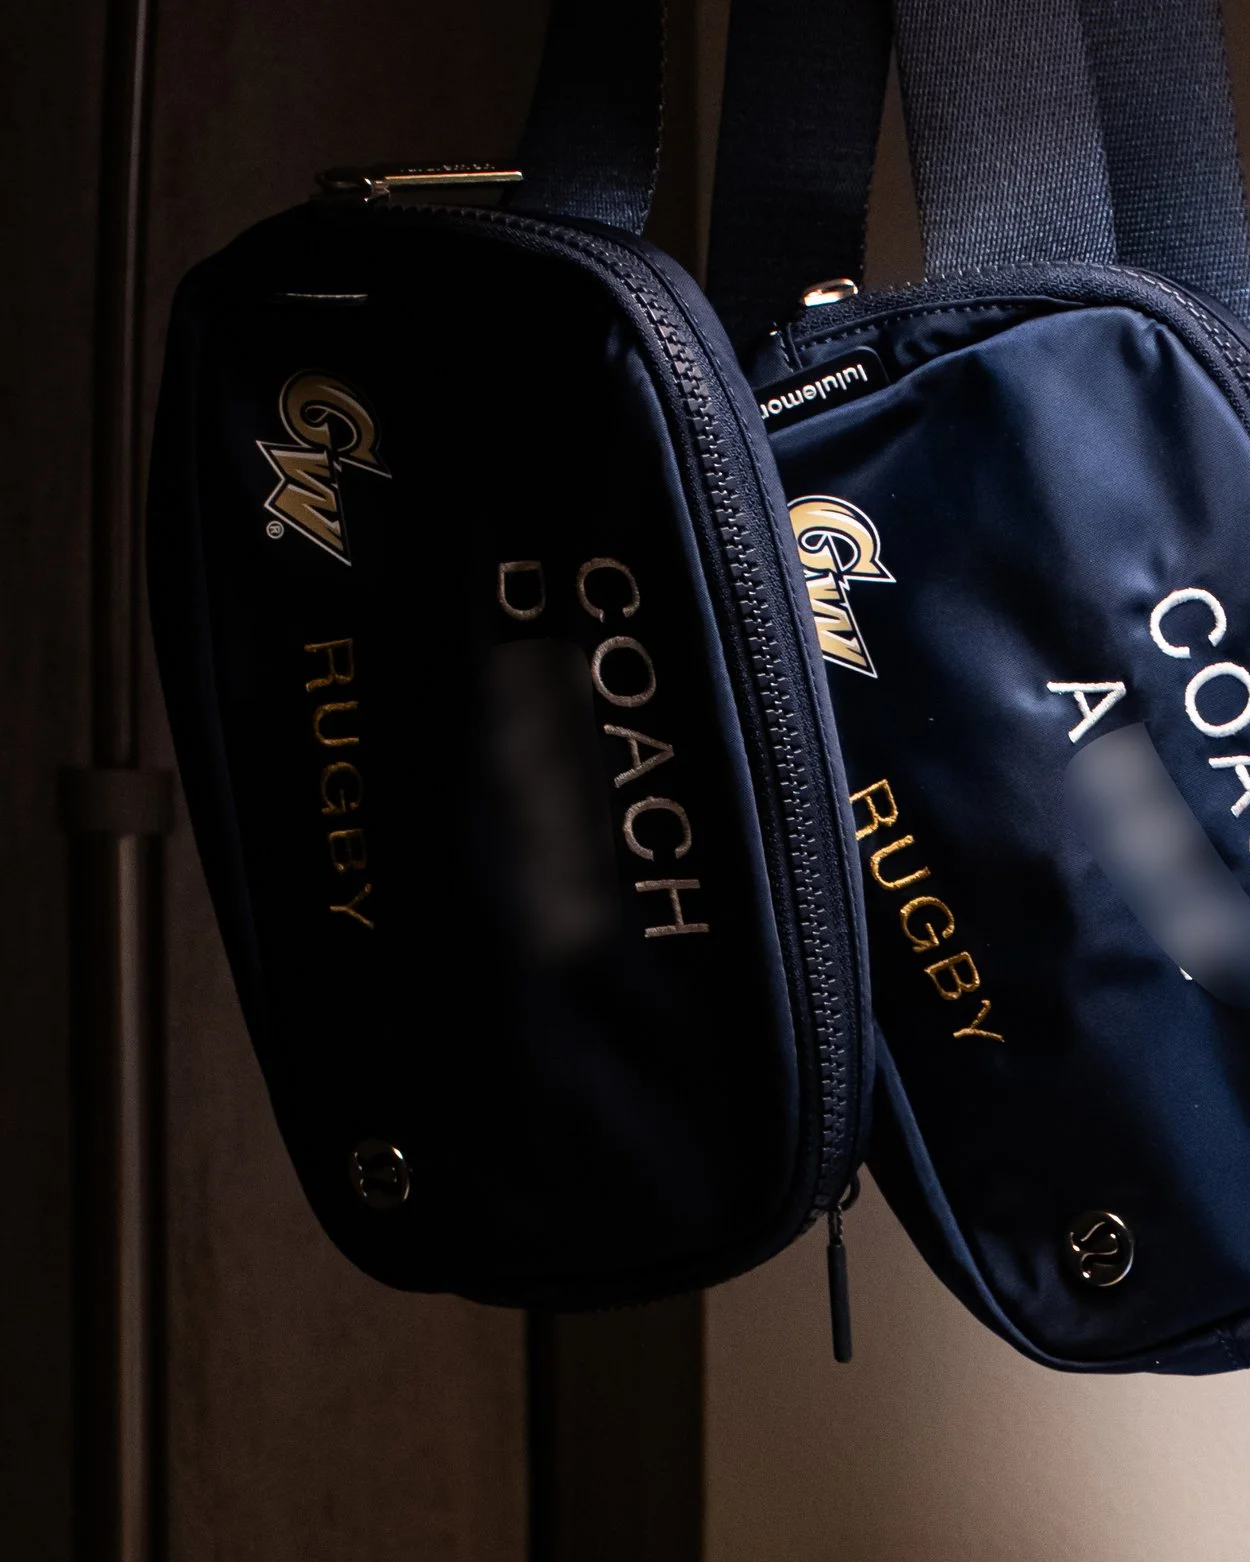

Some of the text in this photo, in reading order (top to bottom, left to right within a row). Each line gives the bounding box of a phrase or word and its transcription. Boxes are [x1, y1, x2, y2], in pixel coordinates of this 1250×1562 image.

[303, 637, 375, 930] RUGBY
[576, 556, 710, 939] COACH
[848, 778, 1006, 1043] RUGBY
